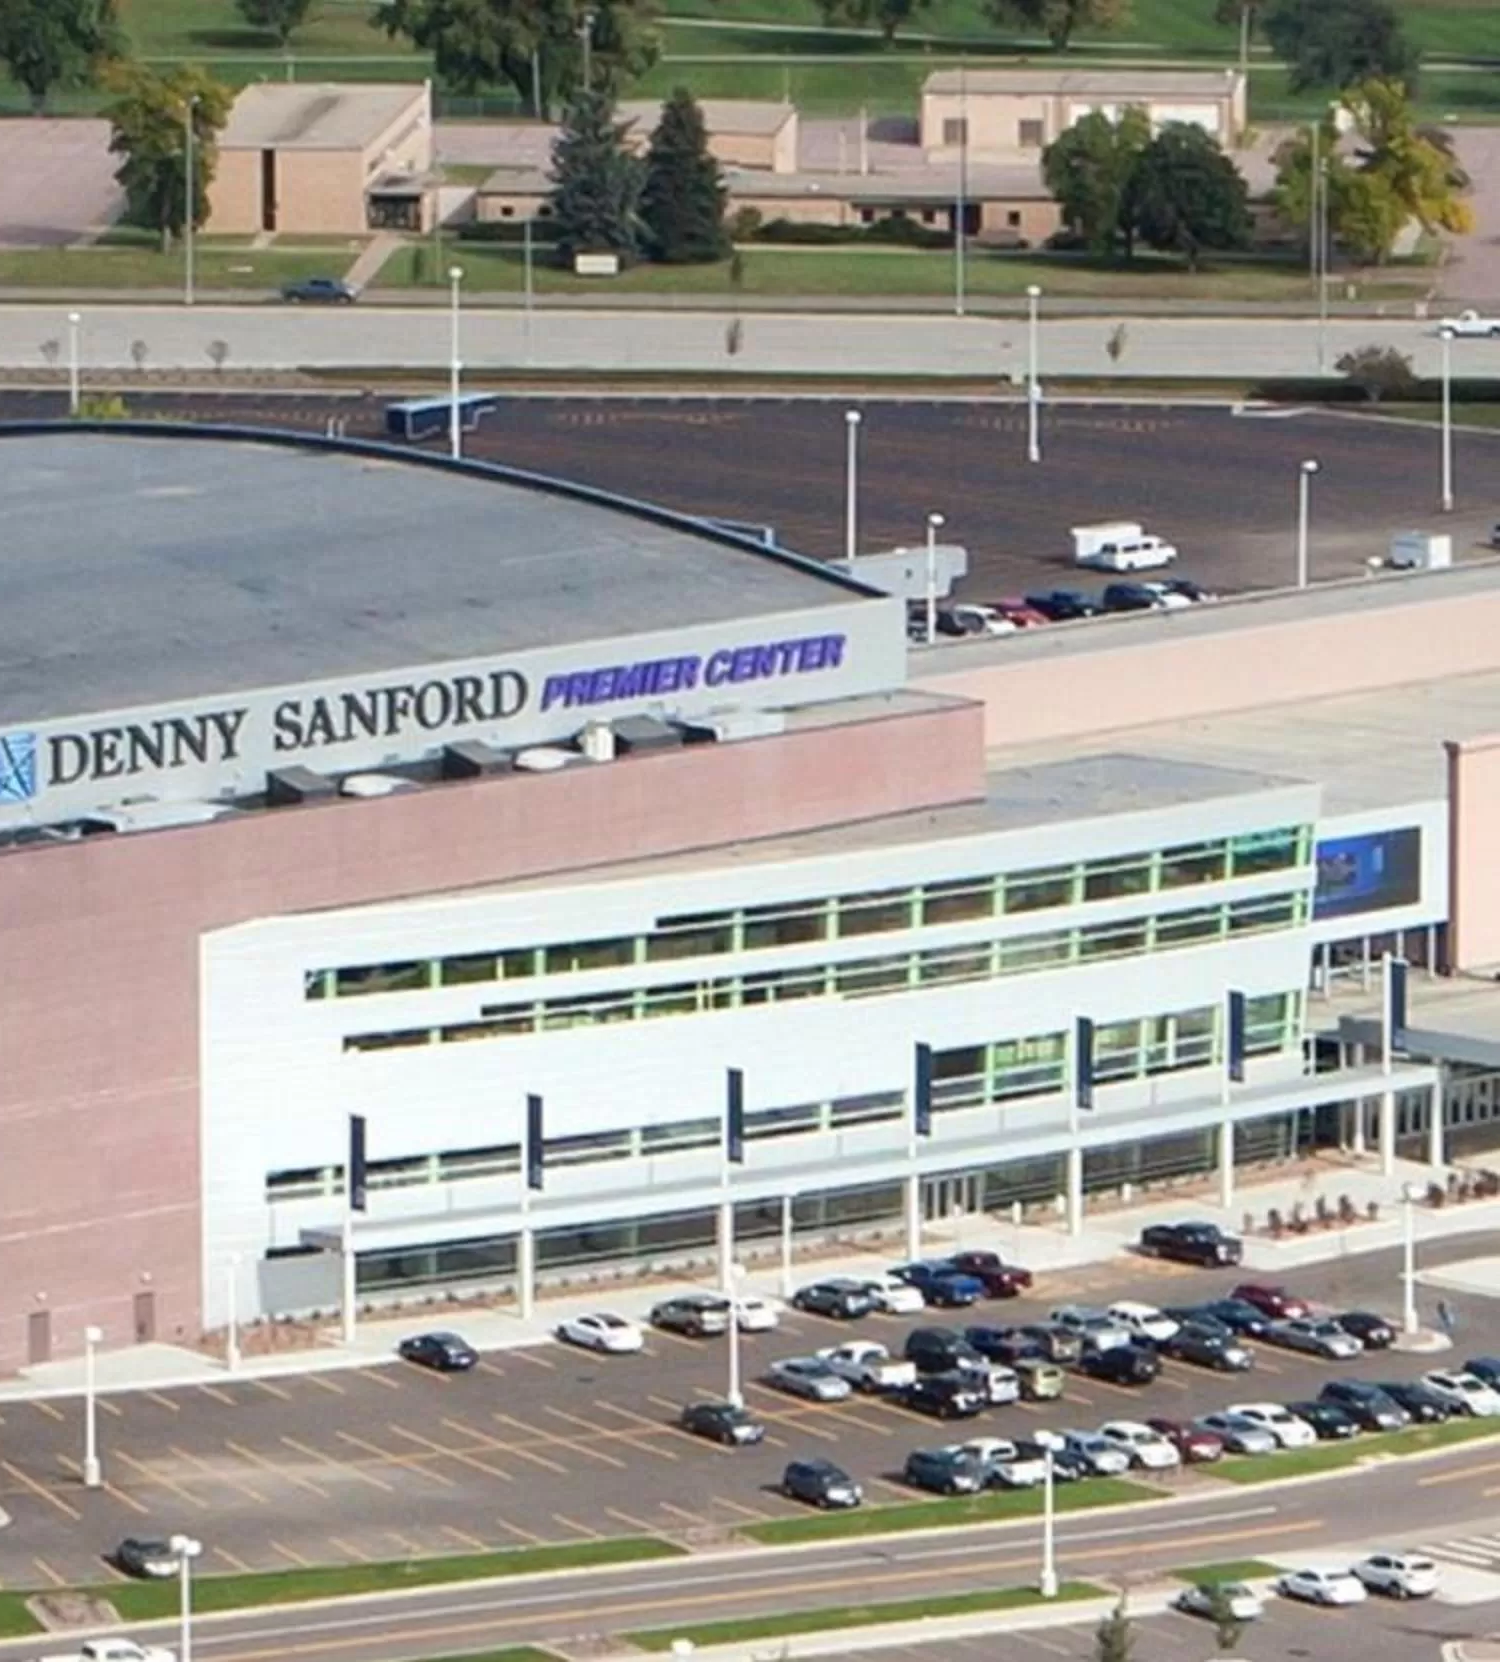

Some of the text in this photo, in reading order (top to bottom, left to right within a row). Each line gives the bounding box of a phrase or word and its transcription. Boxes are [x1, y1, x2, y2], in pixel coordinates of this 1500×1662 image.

[48, 634, 846, 785] DENNY SANFORD PREMIER CENTER
